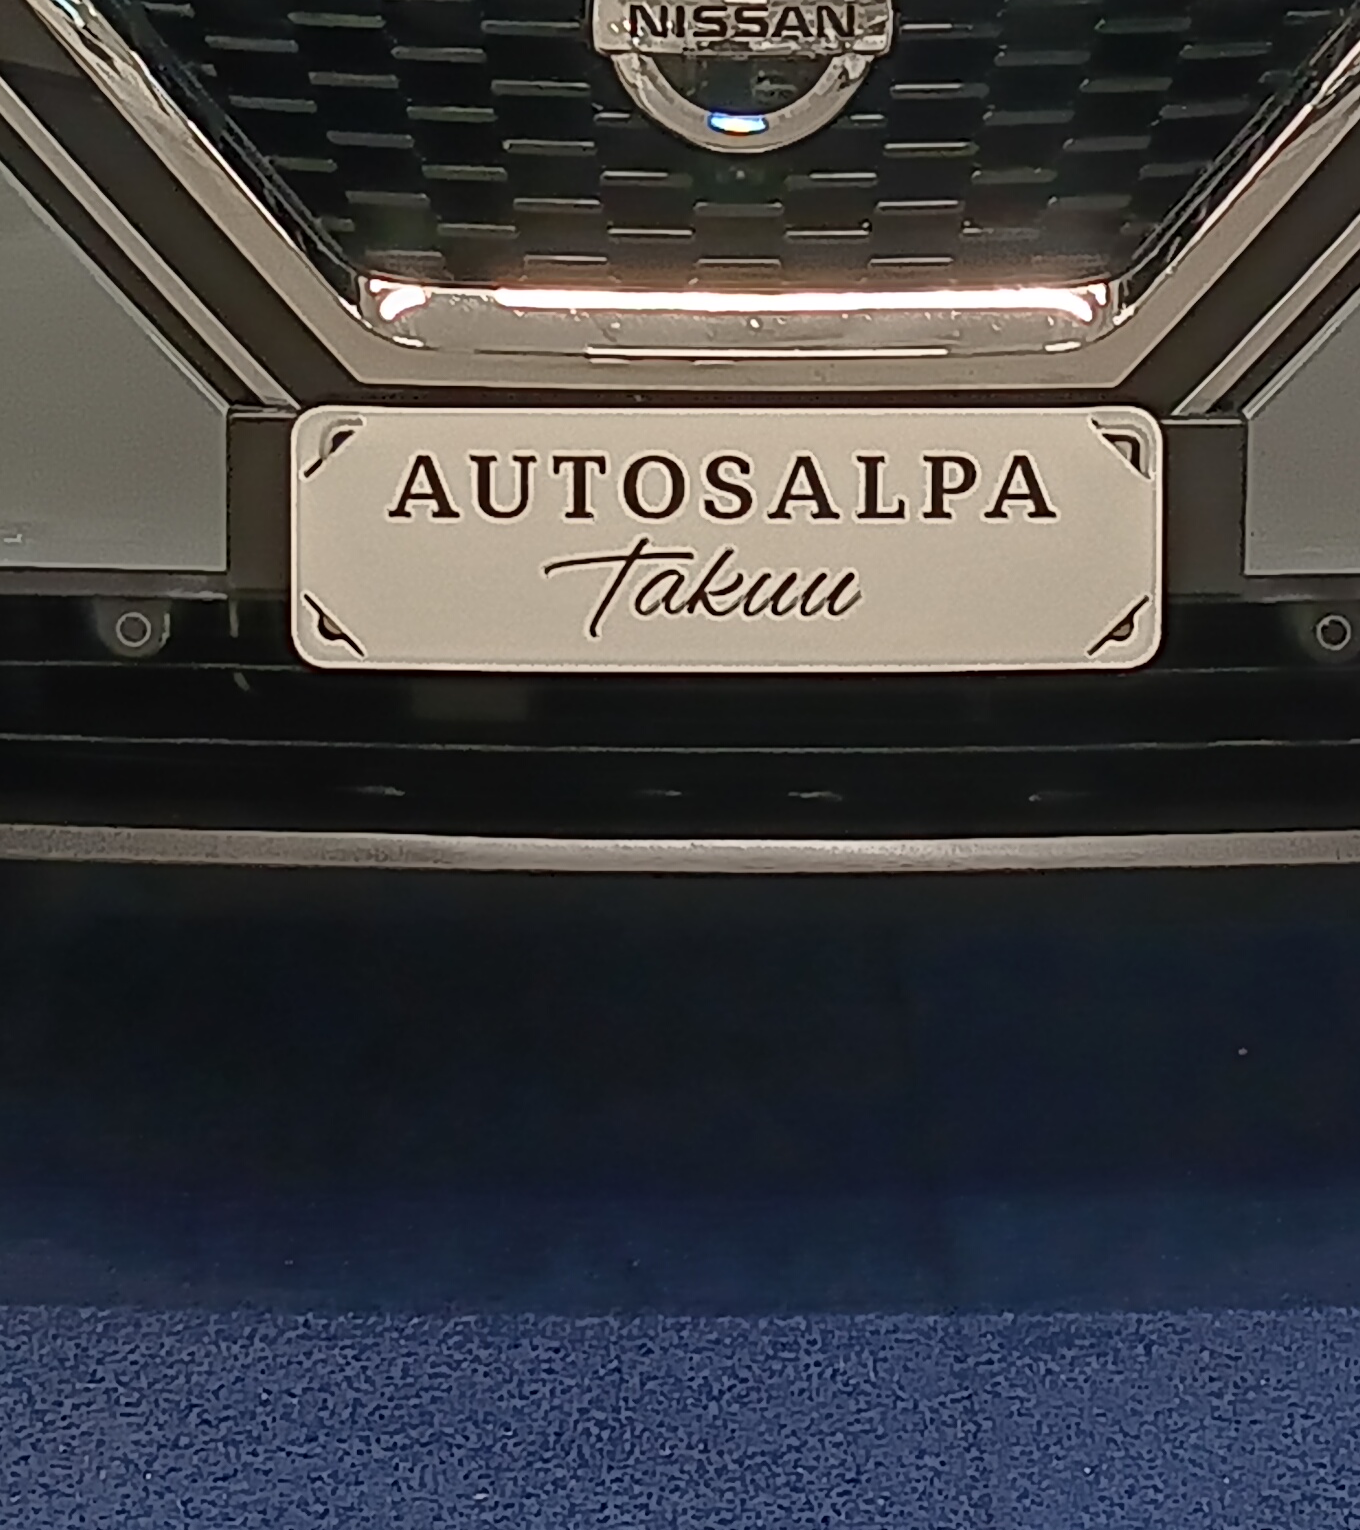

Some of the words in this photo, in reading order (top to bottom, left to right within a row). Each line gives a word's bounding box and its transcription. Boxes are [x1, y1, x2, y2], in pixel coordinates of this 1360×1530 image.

[629, 4, 855, 38] NISSAN
[386, 454, 1058, 521] AUTOSALPA
[542, 536, 864, 639] Takuu
